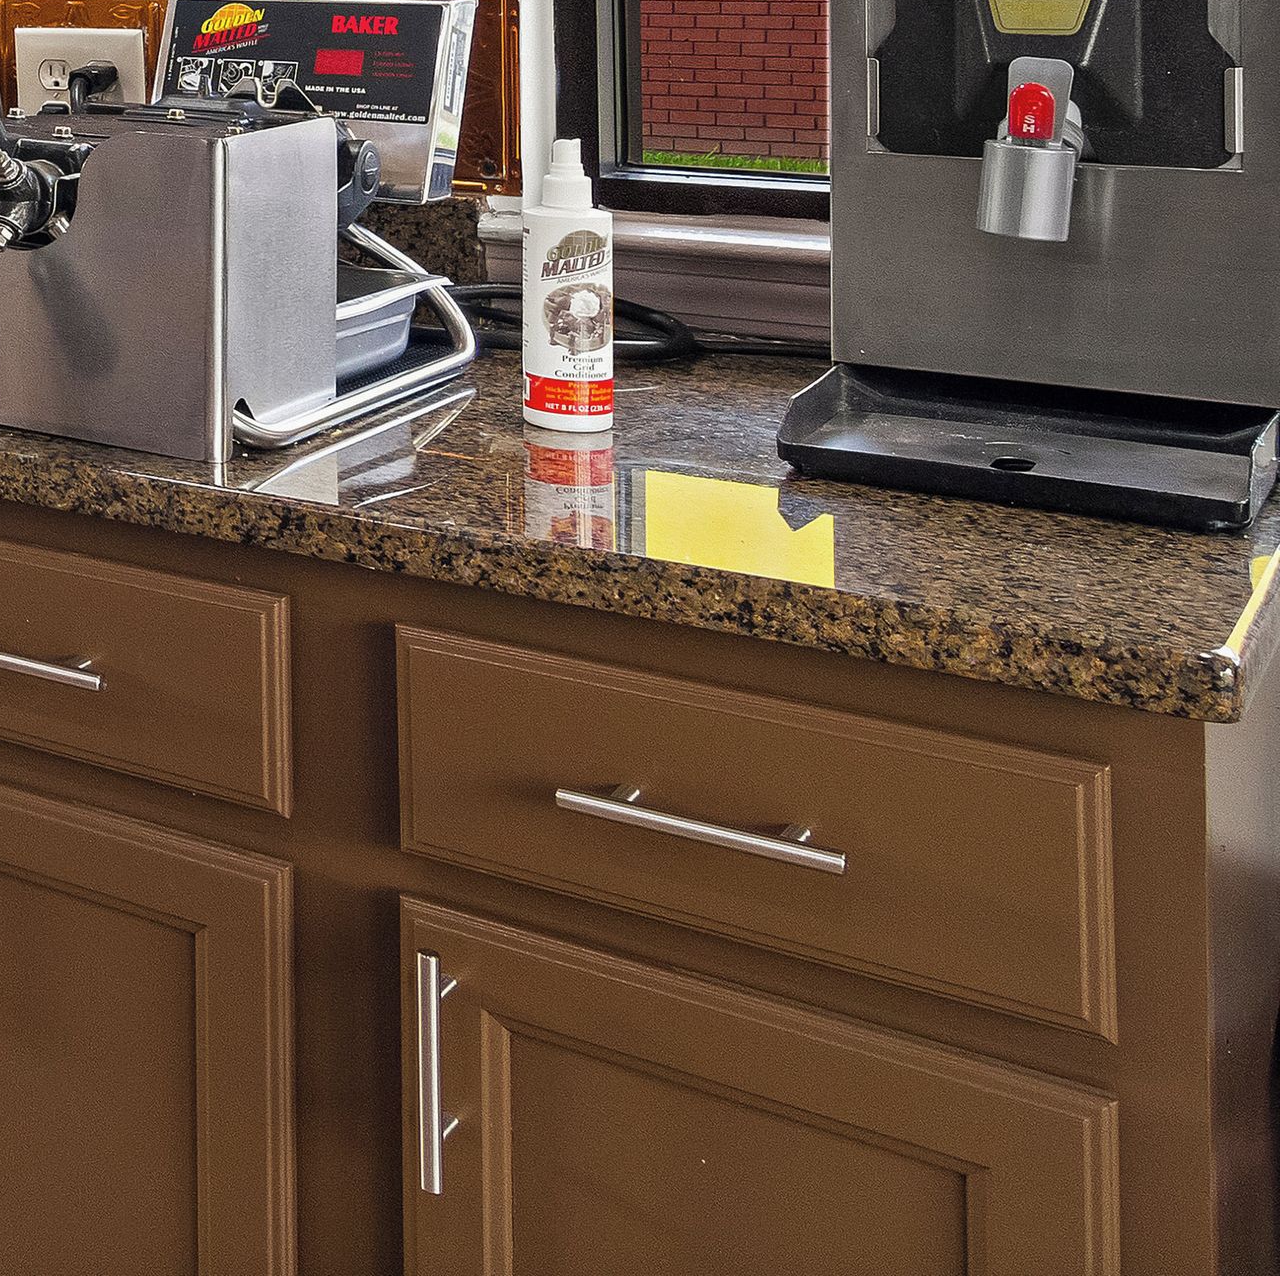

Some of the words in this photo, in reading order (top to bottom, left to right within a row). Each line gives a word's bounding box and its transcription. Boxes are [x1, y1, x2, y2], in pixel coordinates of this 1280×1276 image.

[201, 8, 265, 34] GOLDEN
[331, 15, 399, 35] BAKER
[193, 23, 258, 50] MALTED
[541, 250, 606, 278] MALTED
[562, 355, 603, 364] Premium
[573, 363, 595, 371] Grid
[554, 369, 608, 379] Conditioner
[545, 402, 559, 410] NET
